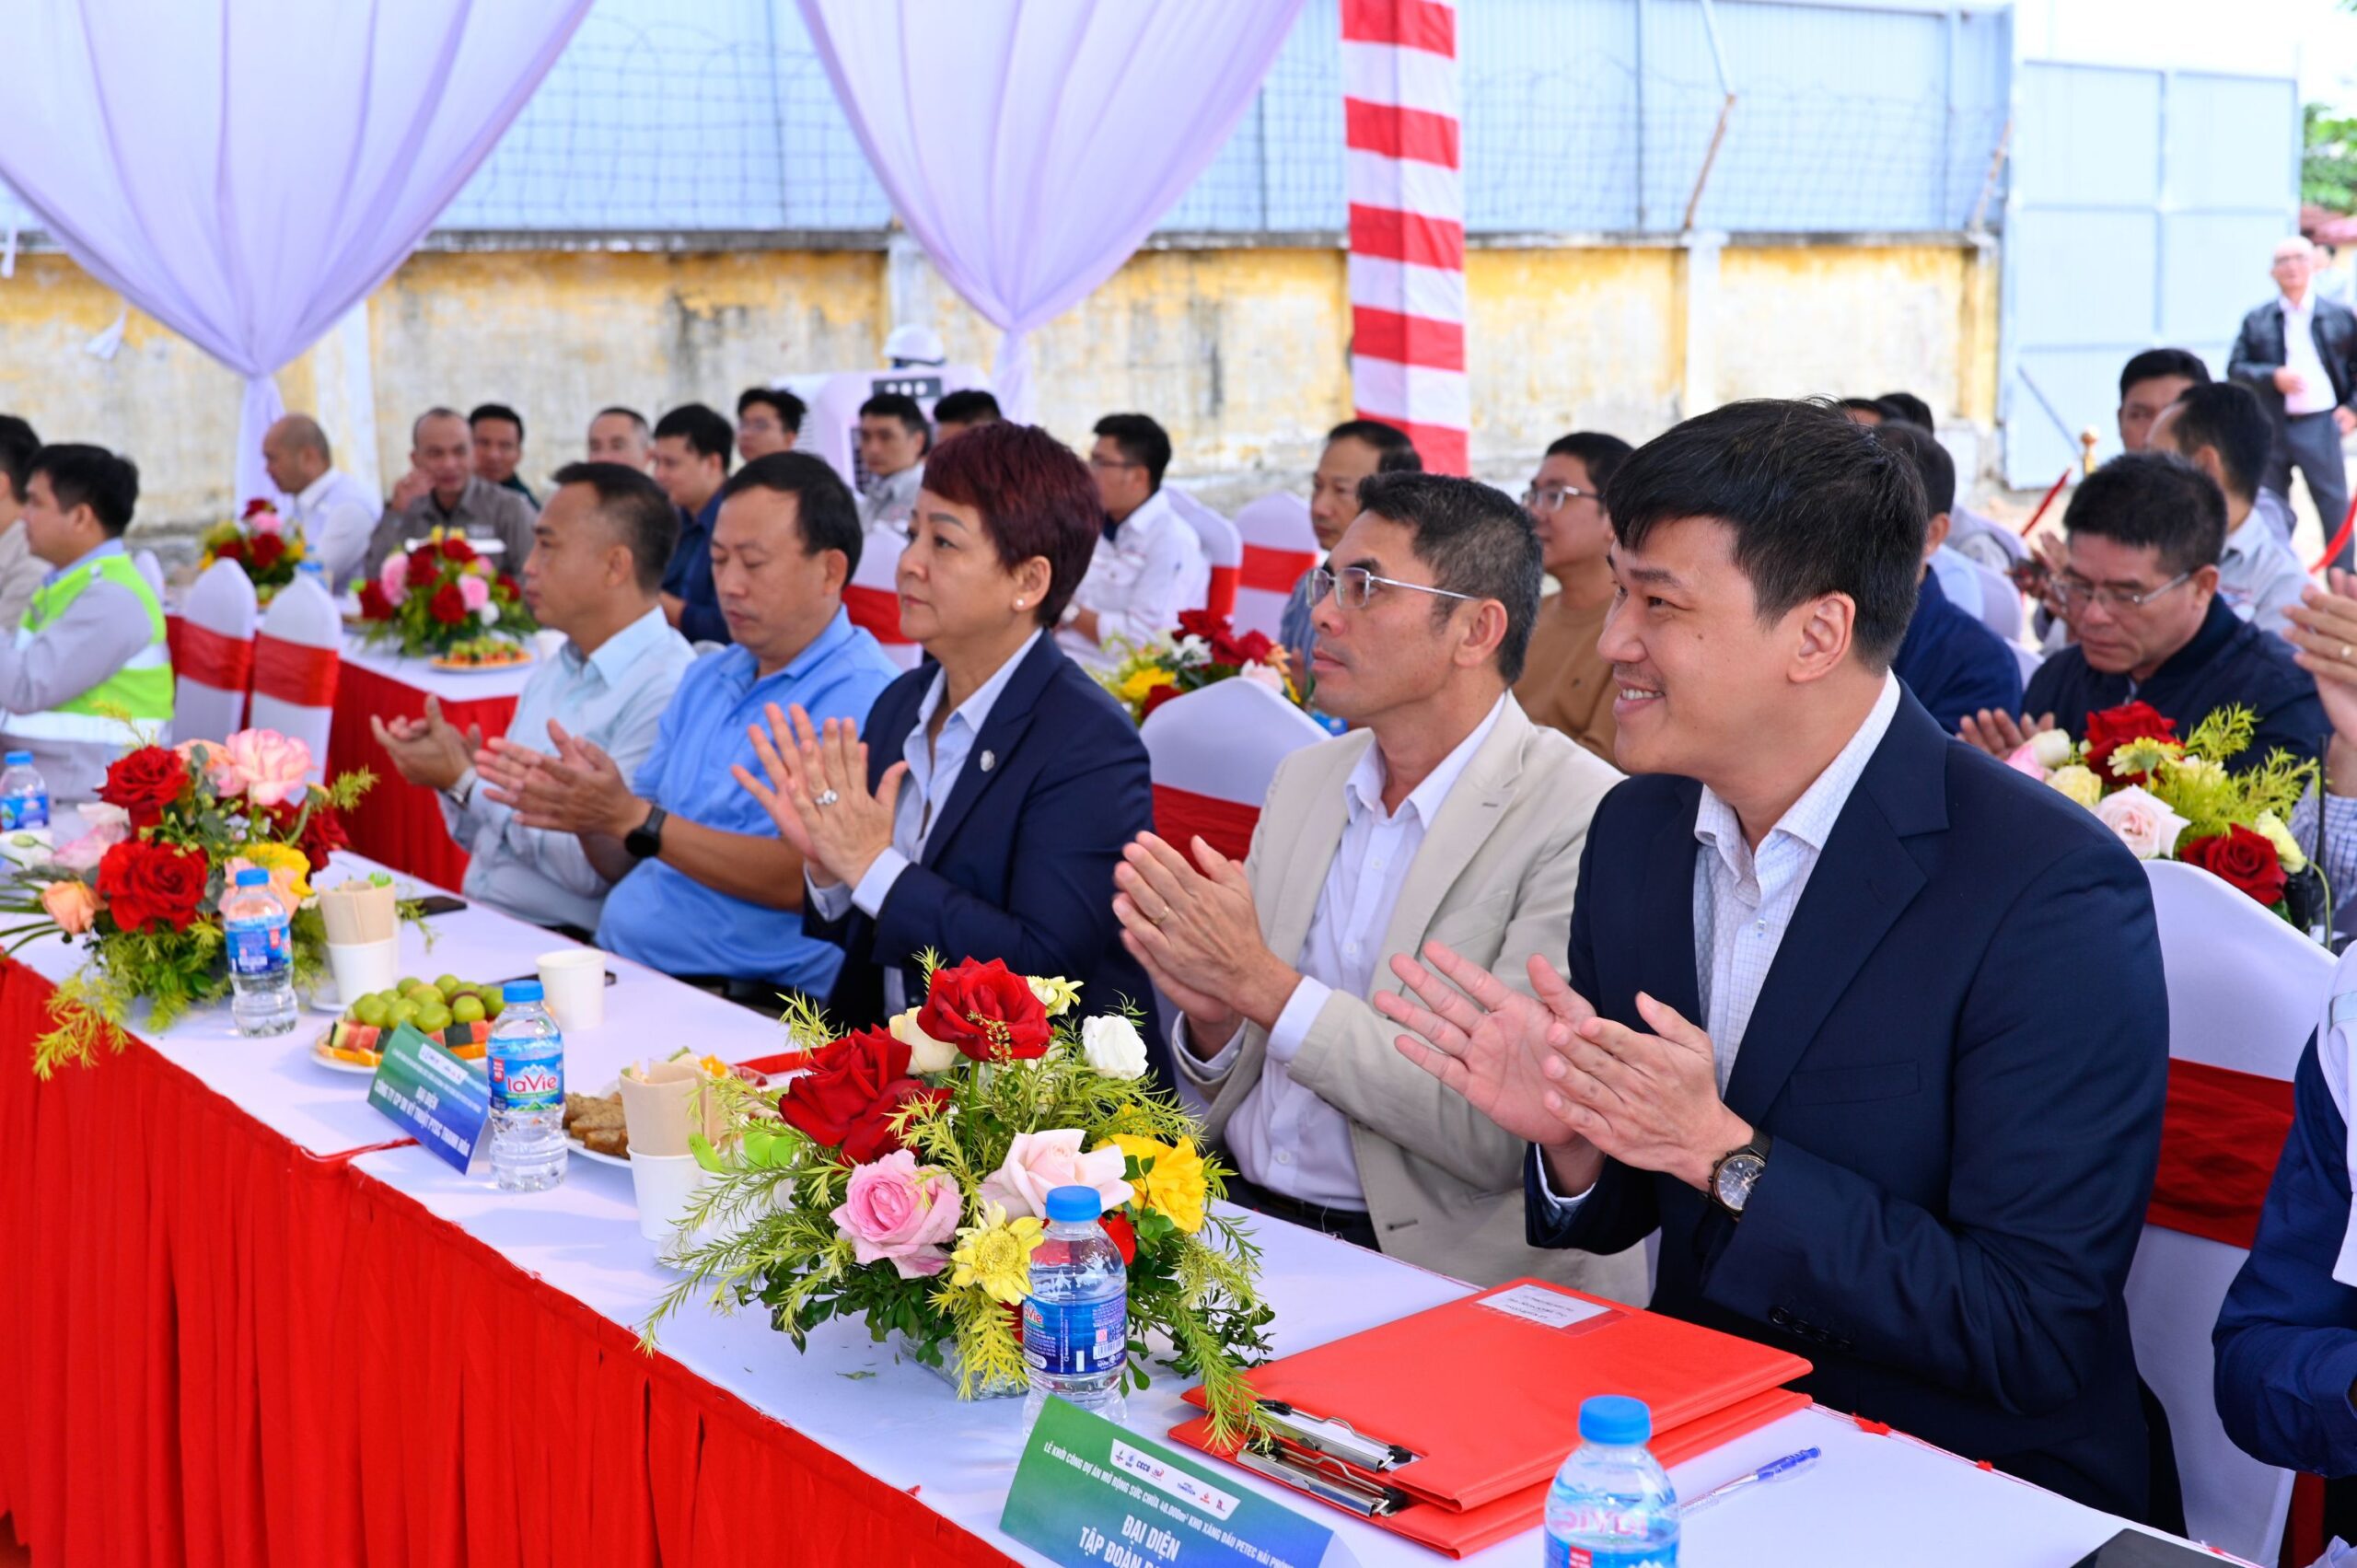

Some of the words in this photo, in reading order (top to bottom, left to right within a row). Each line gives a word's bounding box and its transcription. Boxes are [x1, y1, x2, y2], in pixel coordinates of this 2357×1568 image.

[507, 1074, 557, 1093] laVie
[1079, 1526, 1105, 1556] TẬP
[1104, 1540, 1143, 1568] ĐOÀN
[1121, 1515, 1147, 1545] ĐẠI
[1145, 1527, 1181, 1562] DIỆN
[1235, 1539, 1258, 1559] PETEC
